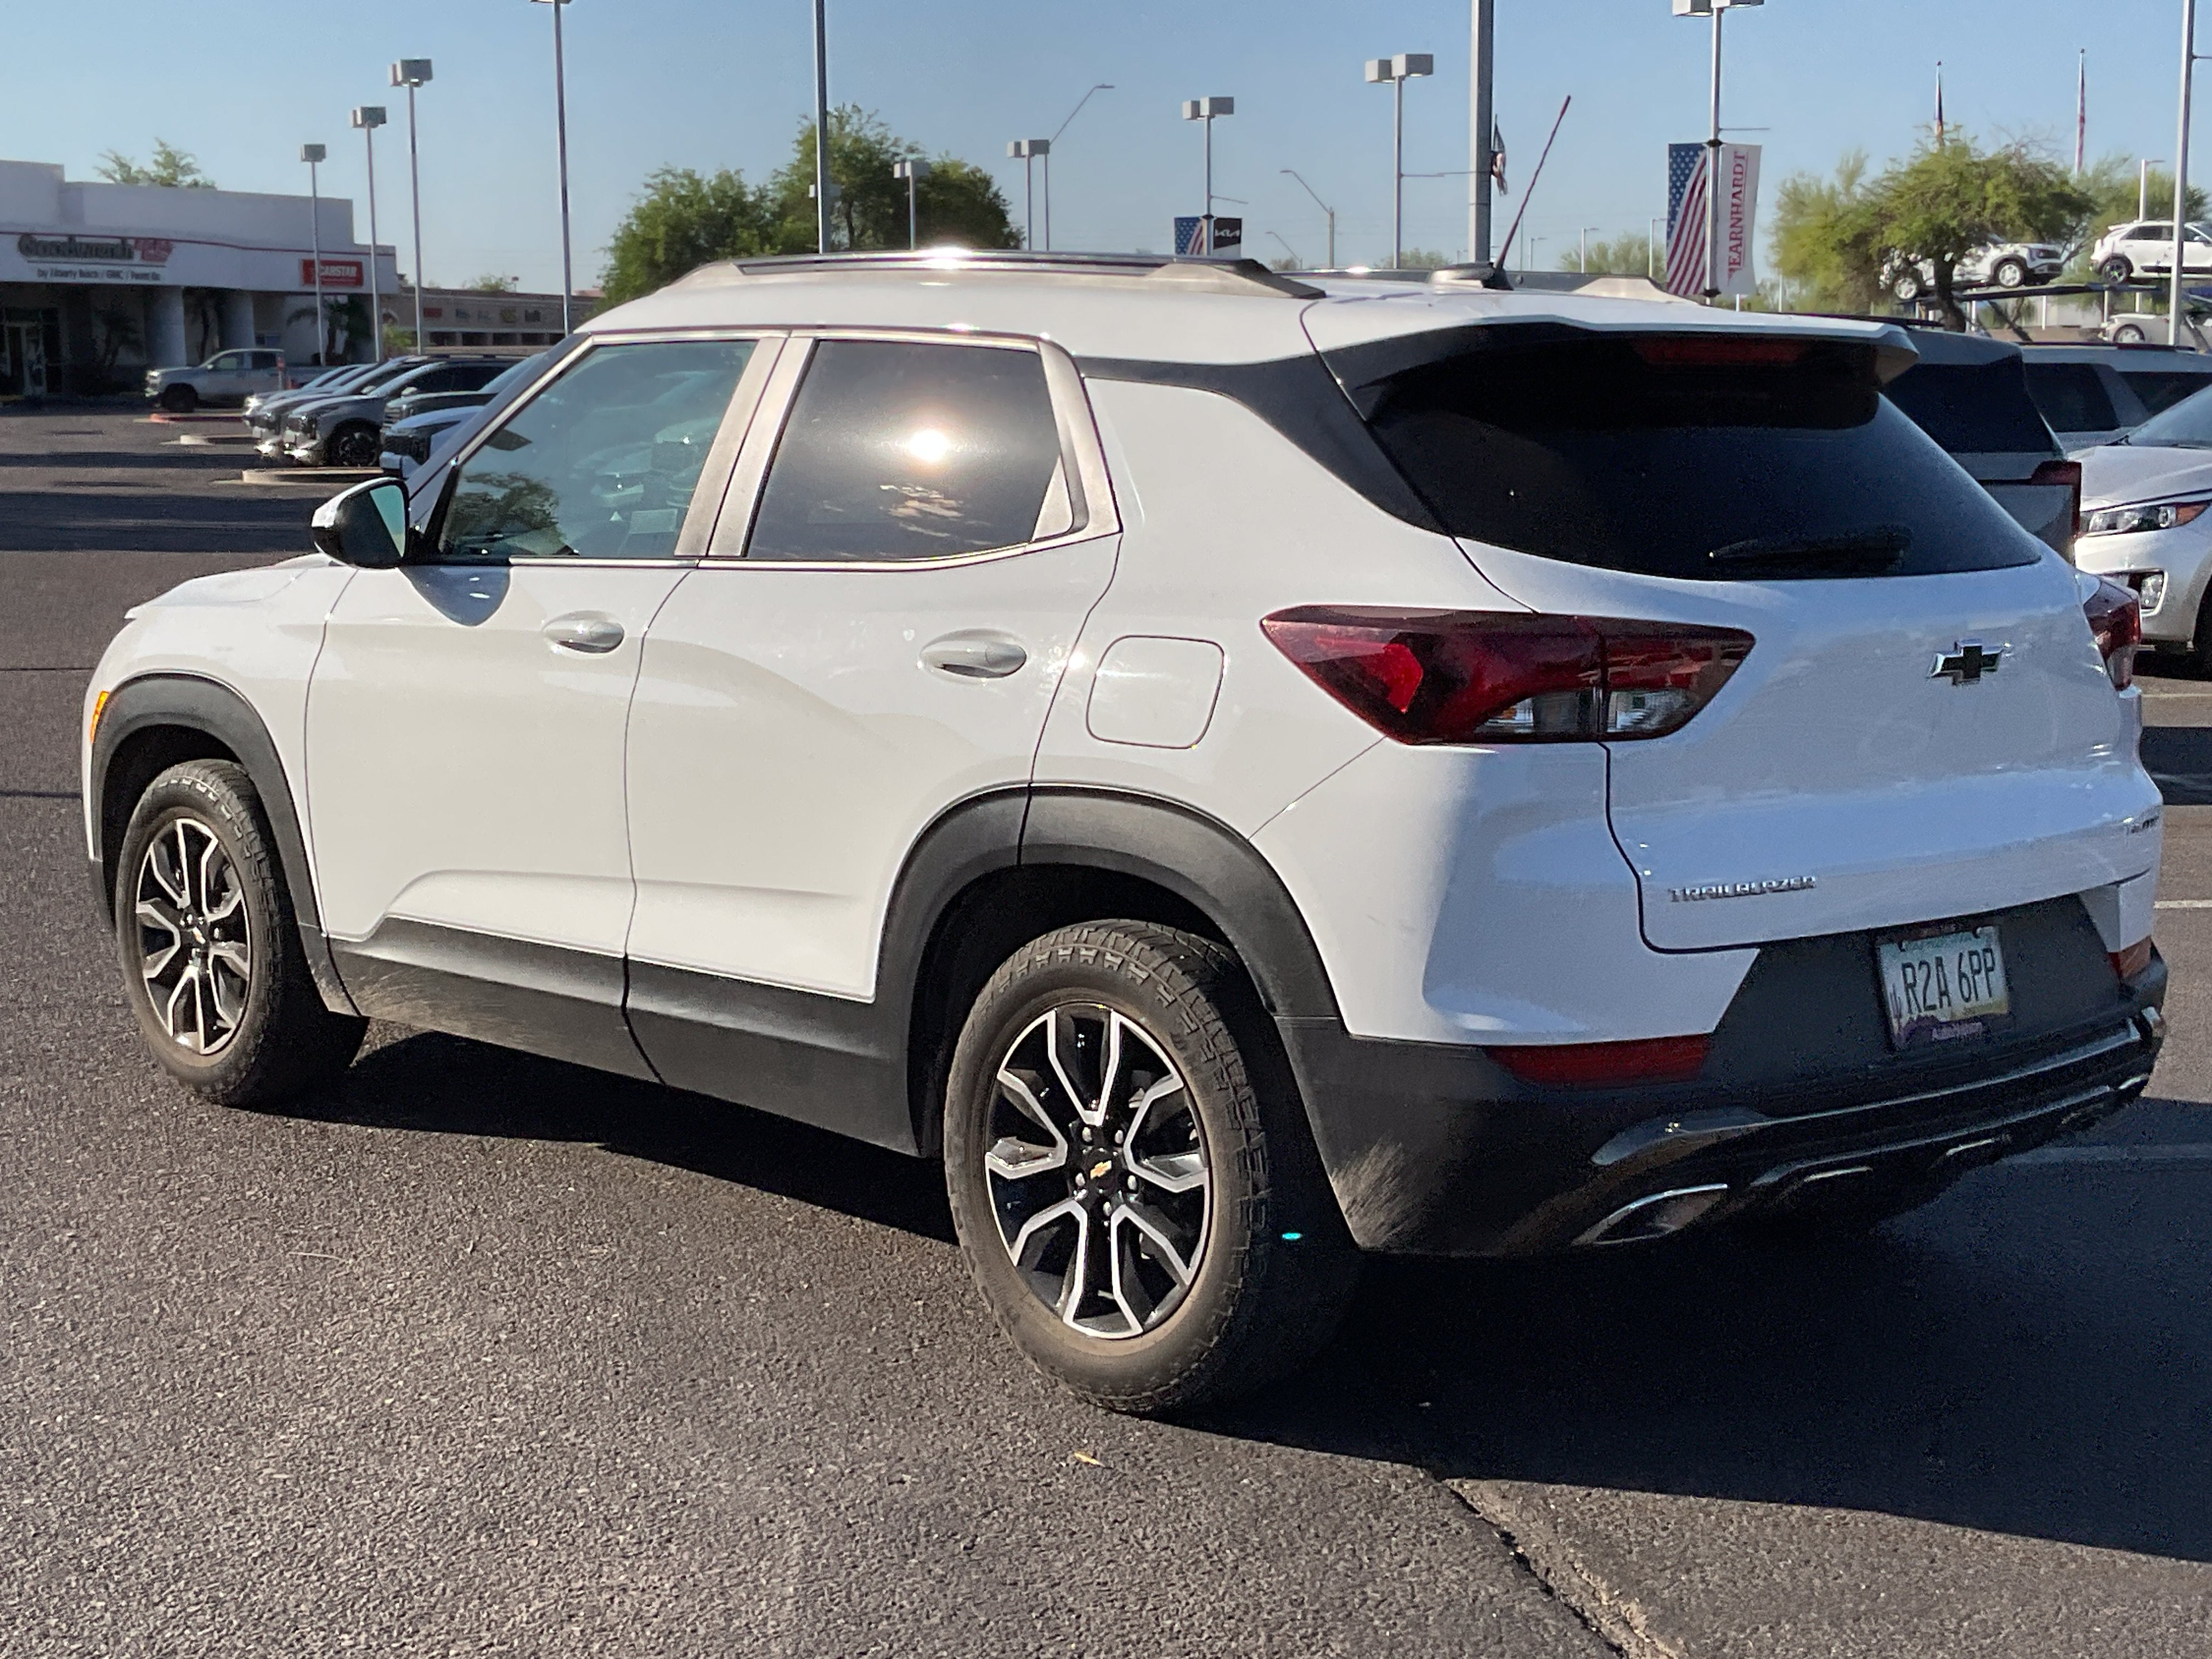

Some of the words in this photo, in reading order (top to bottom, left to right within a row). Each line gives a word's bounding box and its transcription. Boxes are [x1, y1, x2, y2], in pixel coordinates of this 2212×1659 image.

[1728, 151, 1746, 267] EARNHARDT
[1668, 875, 1816, 902] TRAILBLAZER
[1901, 956, 1951, 1014] R2A
[1958, 947, 1995, 1003] 6PP
